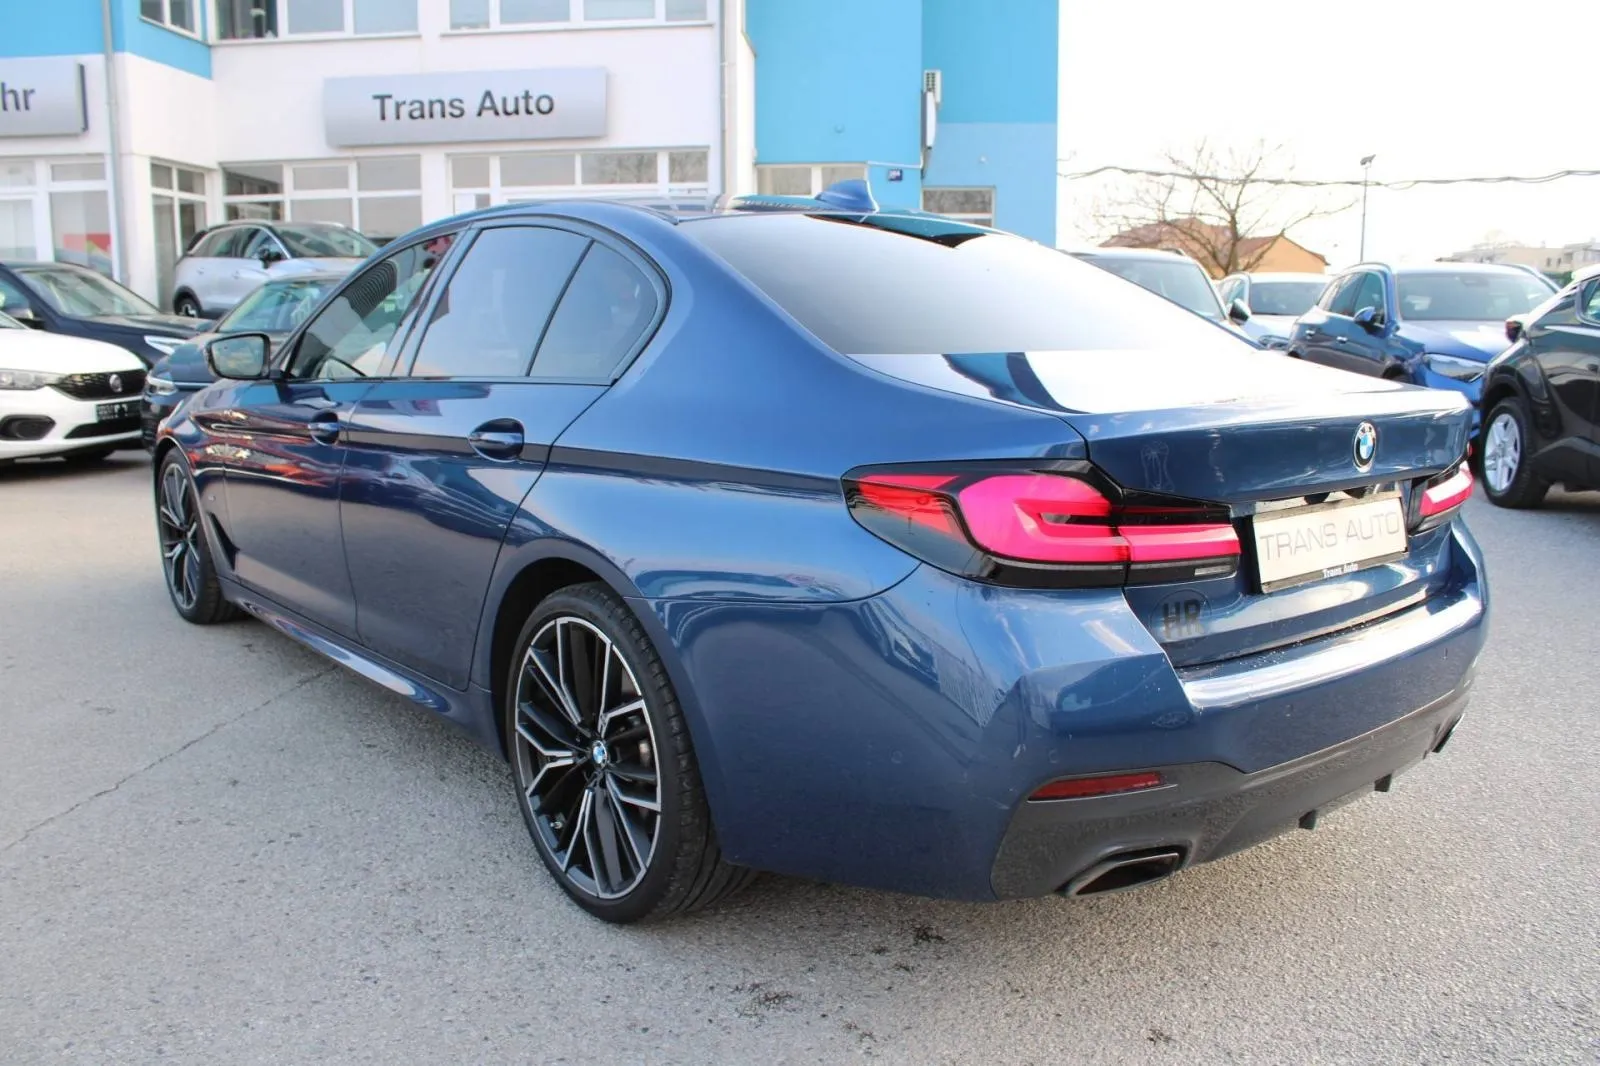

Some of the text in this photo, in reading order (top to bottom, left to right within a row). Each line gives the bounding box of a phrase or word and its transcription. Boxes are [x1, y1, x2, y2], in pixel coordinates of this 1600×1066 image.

[372, 89, 555, 120] Trans Auto
[1259, 511, 1400, 561] TRANS AUTO
[1323, 562, 1359, 579] Trans Auto
[1162, 599, 1203, 638] HR
